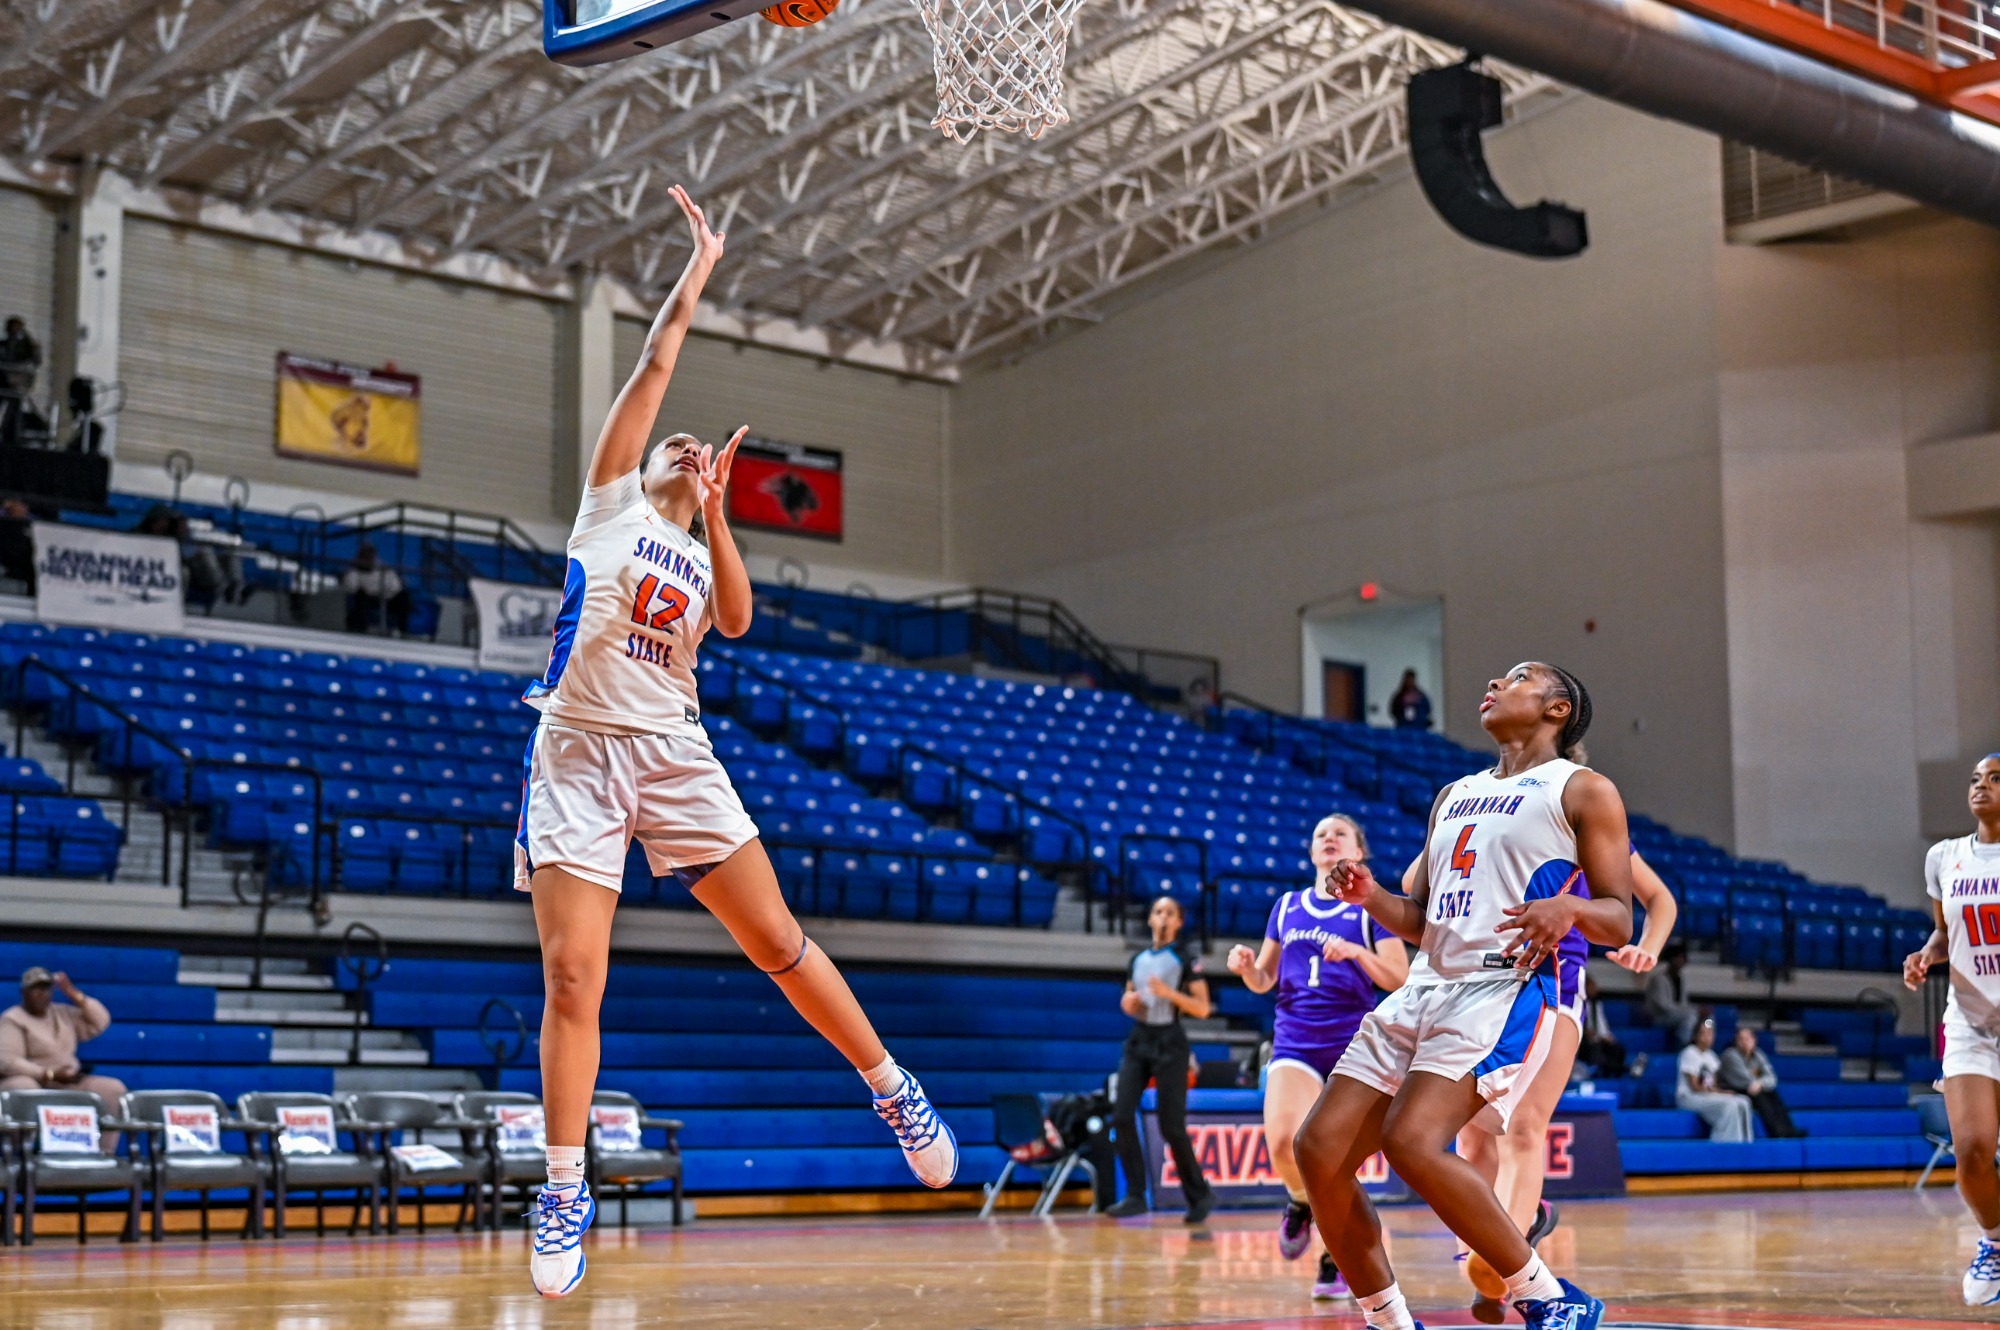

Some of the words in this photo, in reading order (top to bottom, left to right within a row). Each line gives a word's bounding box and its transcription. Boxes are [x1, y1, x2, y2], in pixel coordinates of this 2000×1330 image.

[631, 572, 690, 635] 12
[626, 633, 672, 668] STATE
[1443, 795, 1525, 821] SAVANNAH
[1450, 823, 1477, 879] 4
[1436, 890, 1473, 920] STATE
[1962, 903, 2000, 947] 10
[1307, 955, 1320, 987] 1
